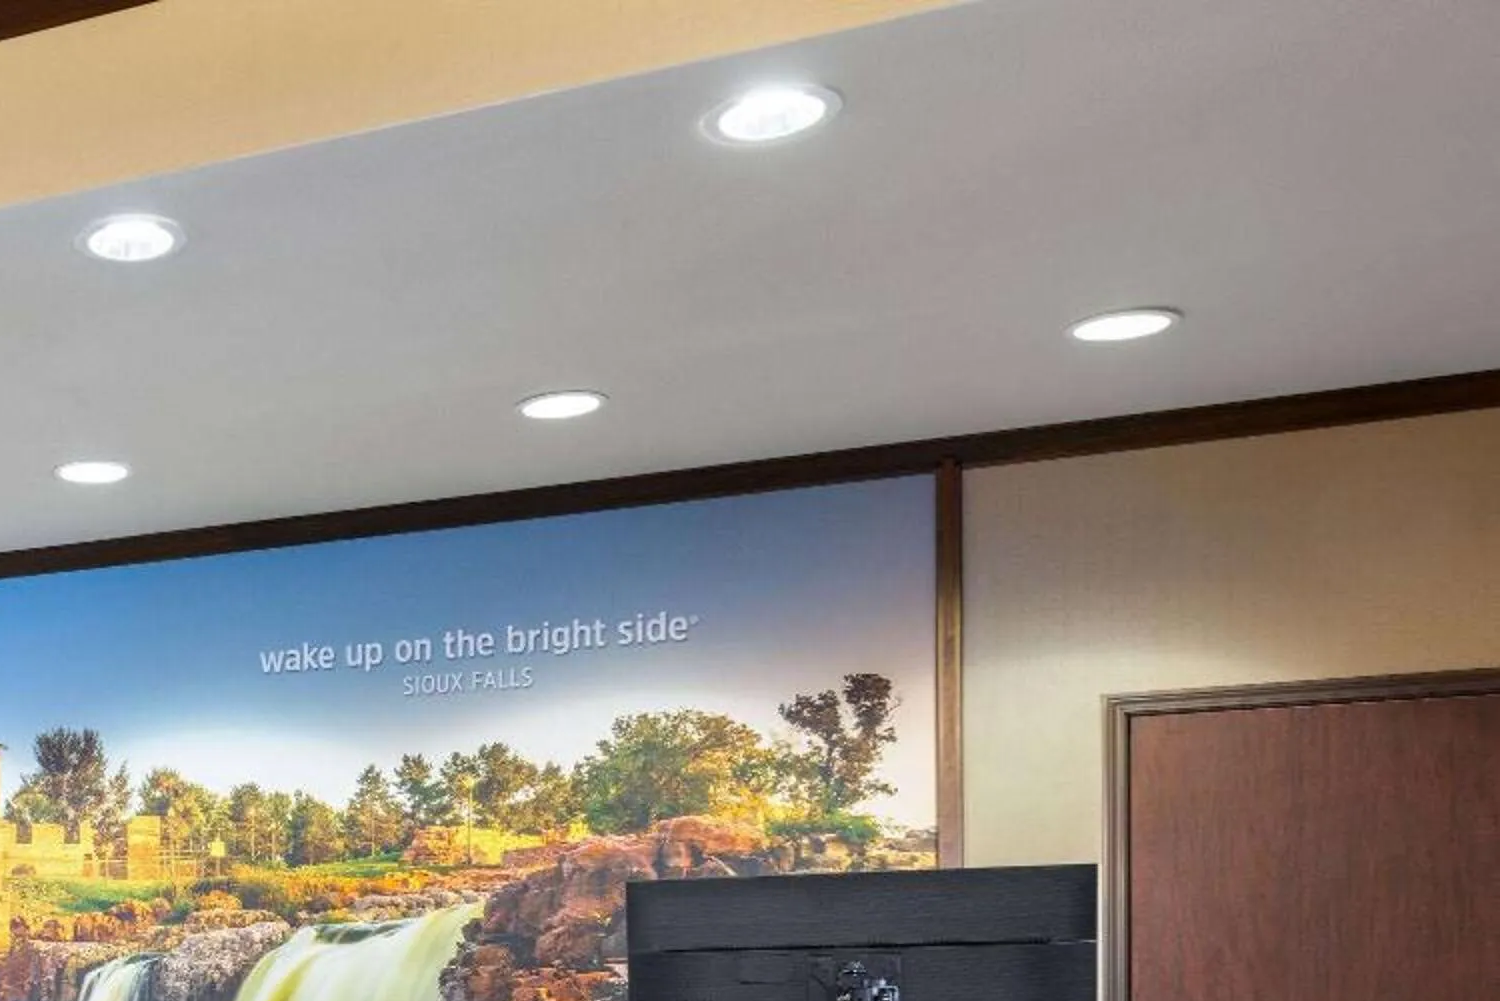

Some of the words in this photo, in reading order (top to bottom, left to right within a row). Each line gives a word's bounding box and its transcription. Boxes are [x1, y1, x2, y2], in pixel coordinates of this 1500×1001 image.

[259, 642, 336, 673] wake
[346, 642, 383, 672] up
[395, 637, 432, 662] on
[443, 629, 495, 658] the
[506, 618, 606, 655] bright
[402, 672, 464, 695] SIOUX
[471, 667, 534, 690] FALLS
